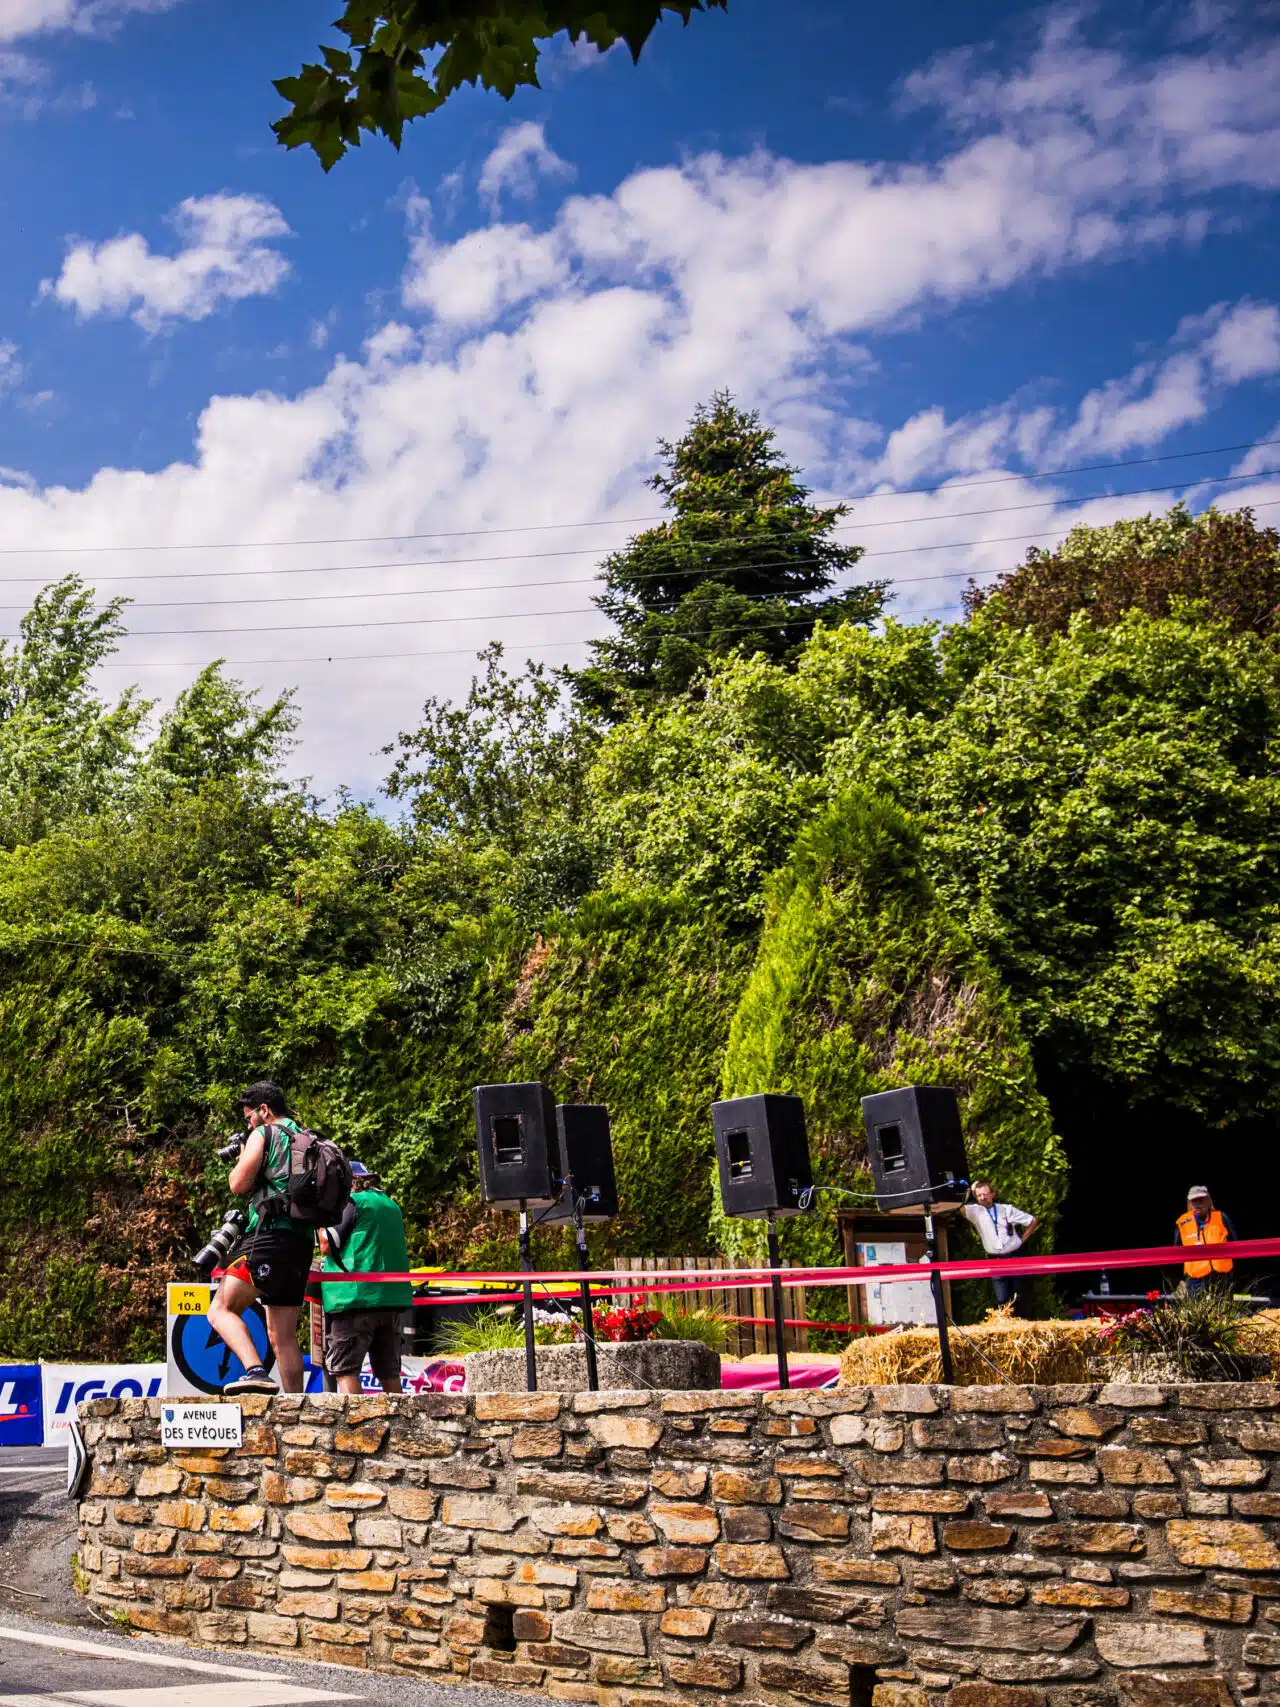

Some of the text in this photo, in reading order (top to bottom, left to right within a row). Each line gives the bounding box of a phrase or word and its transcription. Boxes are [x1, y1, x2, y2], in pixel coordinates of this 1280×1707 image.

[183, 1290, 195, 1298] PK
[177, 1302, 202, 1312] 10.8
[183, 1410, 217, 1420] AVENUE
[164, 1425, 238, 1440] DES EVÊQUES
